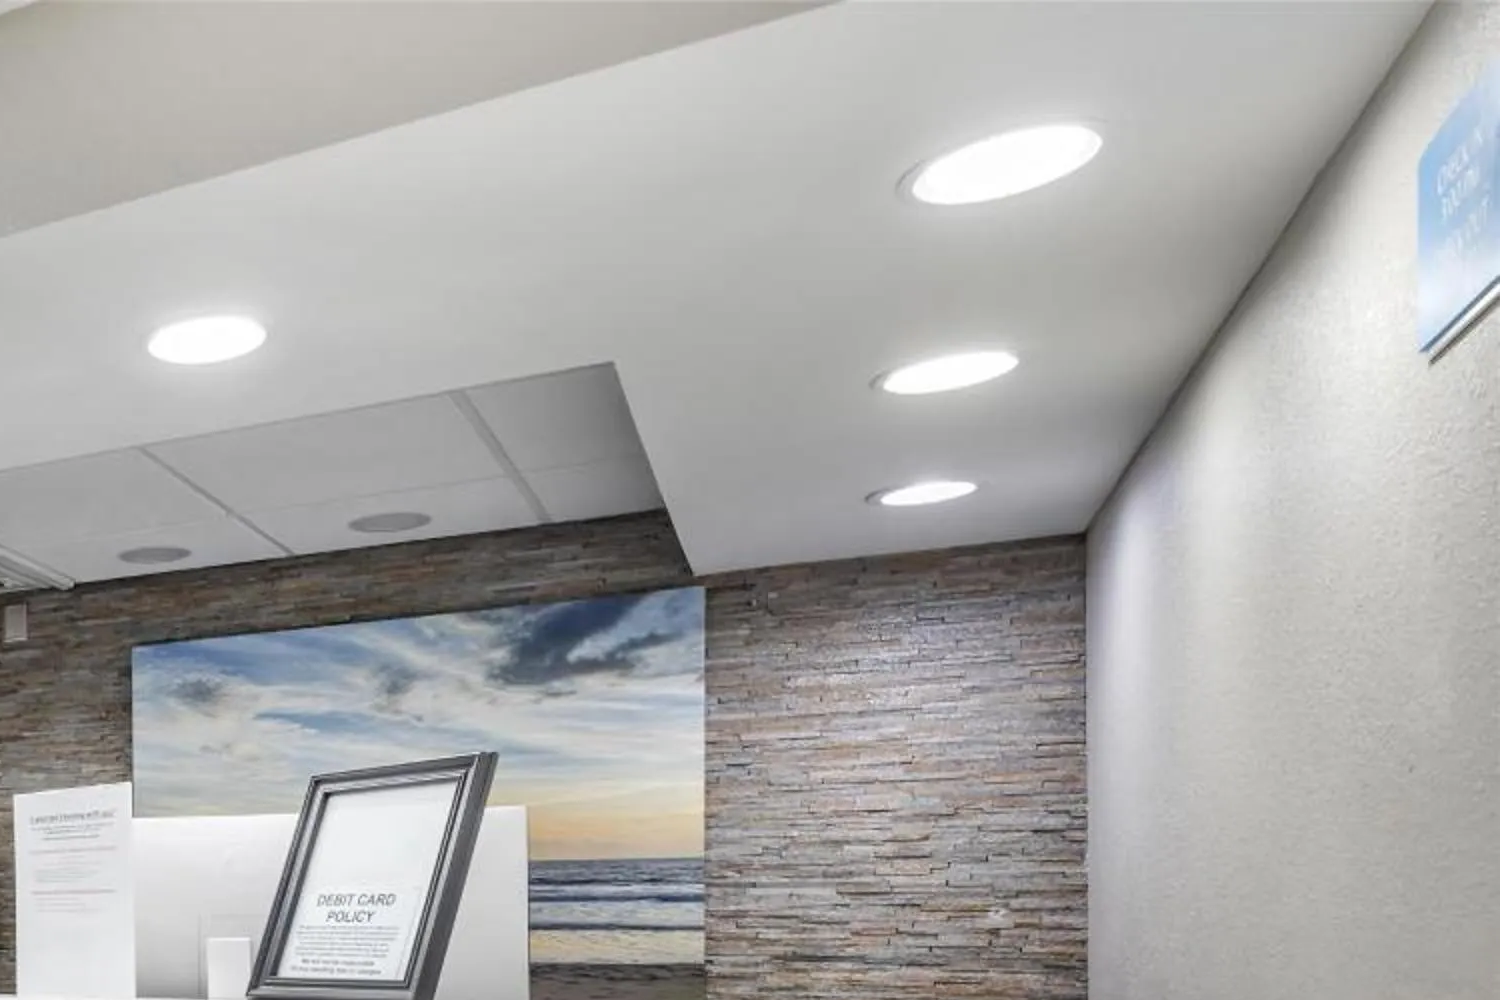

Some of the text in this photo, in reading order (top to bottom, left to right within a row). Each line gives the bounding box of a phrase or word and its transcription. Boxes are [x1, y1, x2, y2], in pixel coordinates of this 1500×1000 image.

[316, 893, 397, 907] DEBIT CARD
[325, 910, 376, 923] POLICY
